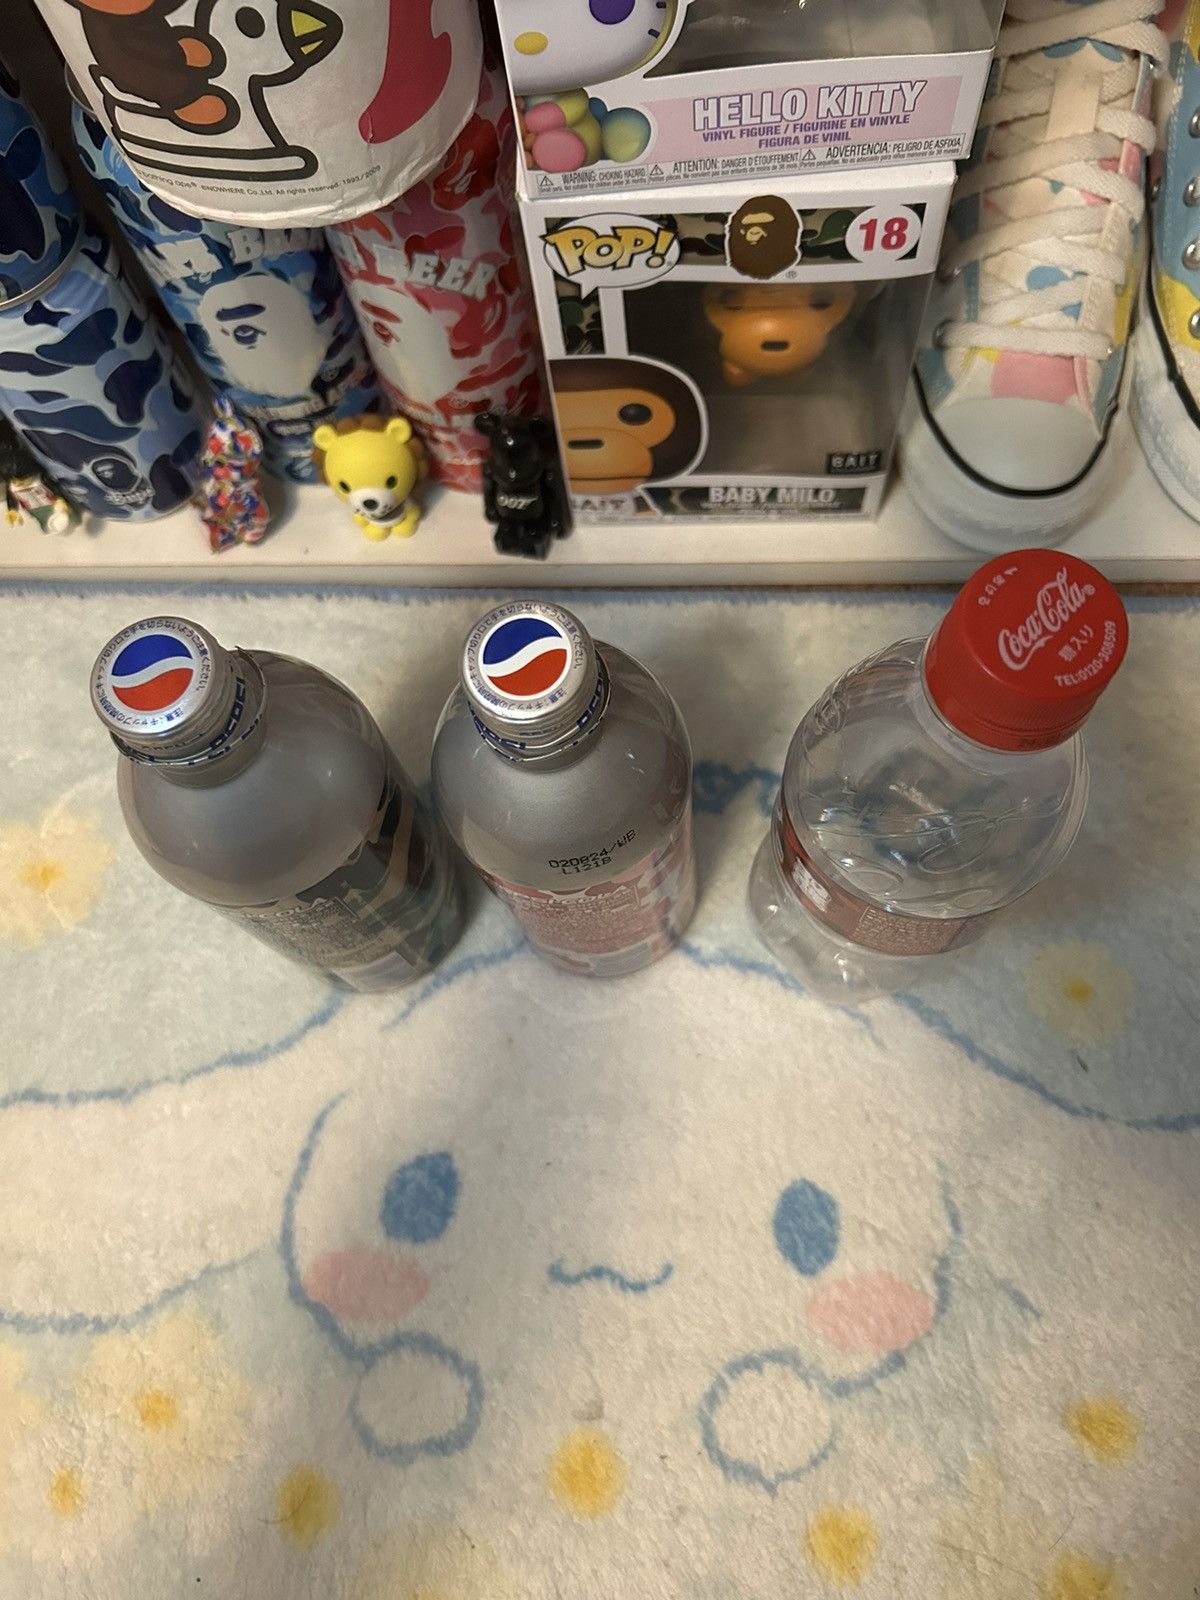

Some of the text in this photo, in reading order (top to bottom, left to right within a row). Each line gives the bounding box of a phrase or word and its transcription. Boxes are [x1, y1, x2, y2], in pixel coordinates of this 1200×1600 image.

[692, 80, 928, 132] HELLO KITTY
[702, 130, 736, 143] VINYL
[739, 125, 781, 138] FIGURE
[793, 119, 847, 133] FIGURINE
[850, 117, 866, 129] EN
[869, 114, 911, 127] VINYLE
[758, 131, 852, 149] FIGURA DE VINIL
[826, 137, 961, 160] ADVERTENCIA: PELIGRO DE ASFIXIA
[673, 158, 720, 173] ATTENTION:
[721, 156, 747, 168] DANGER
[859, 216, 909, 252] 18
[538, 225, 679, 277] POP!
[709, 486, 836, 503] BABY MILO
